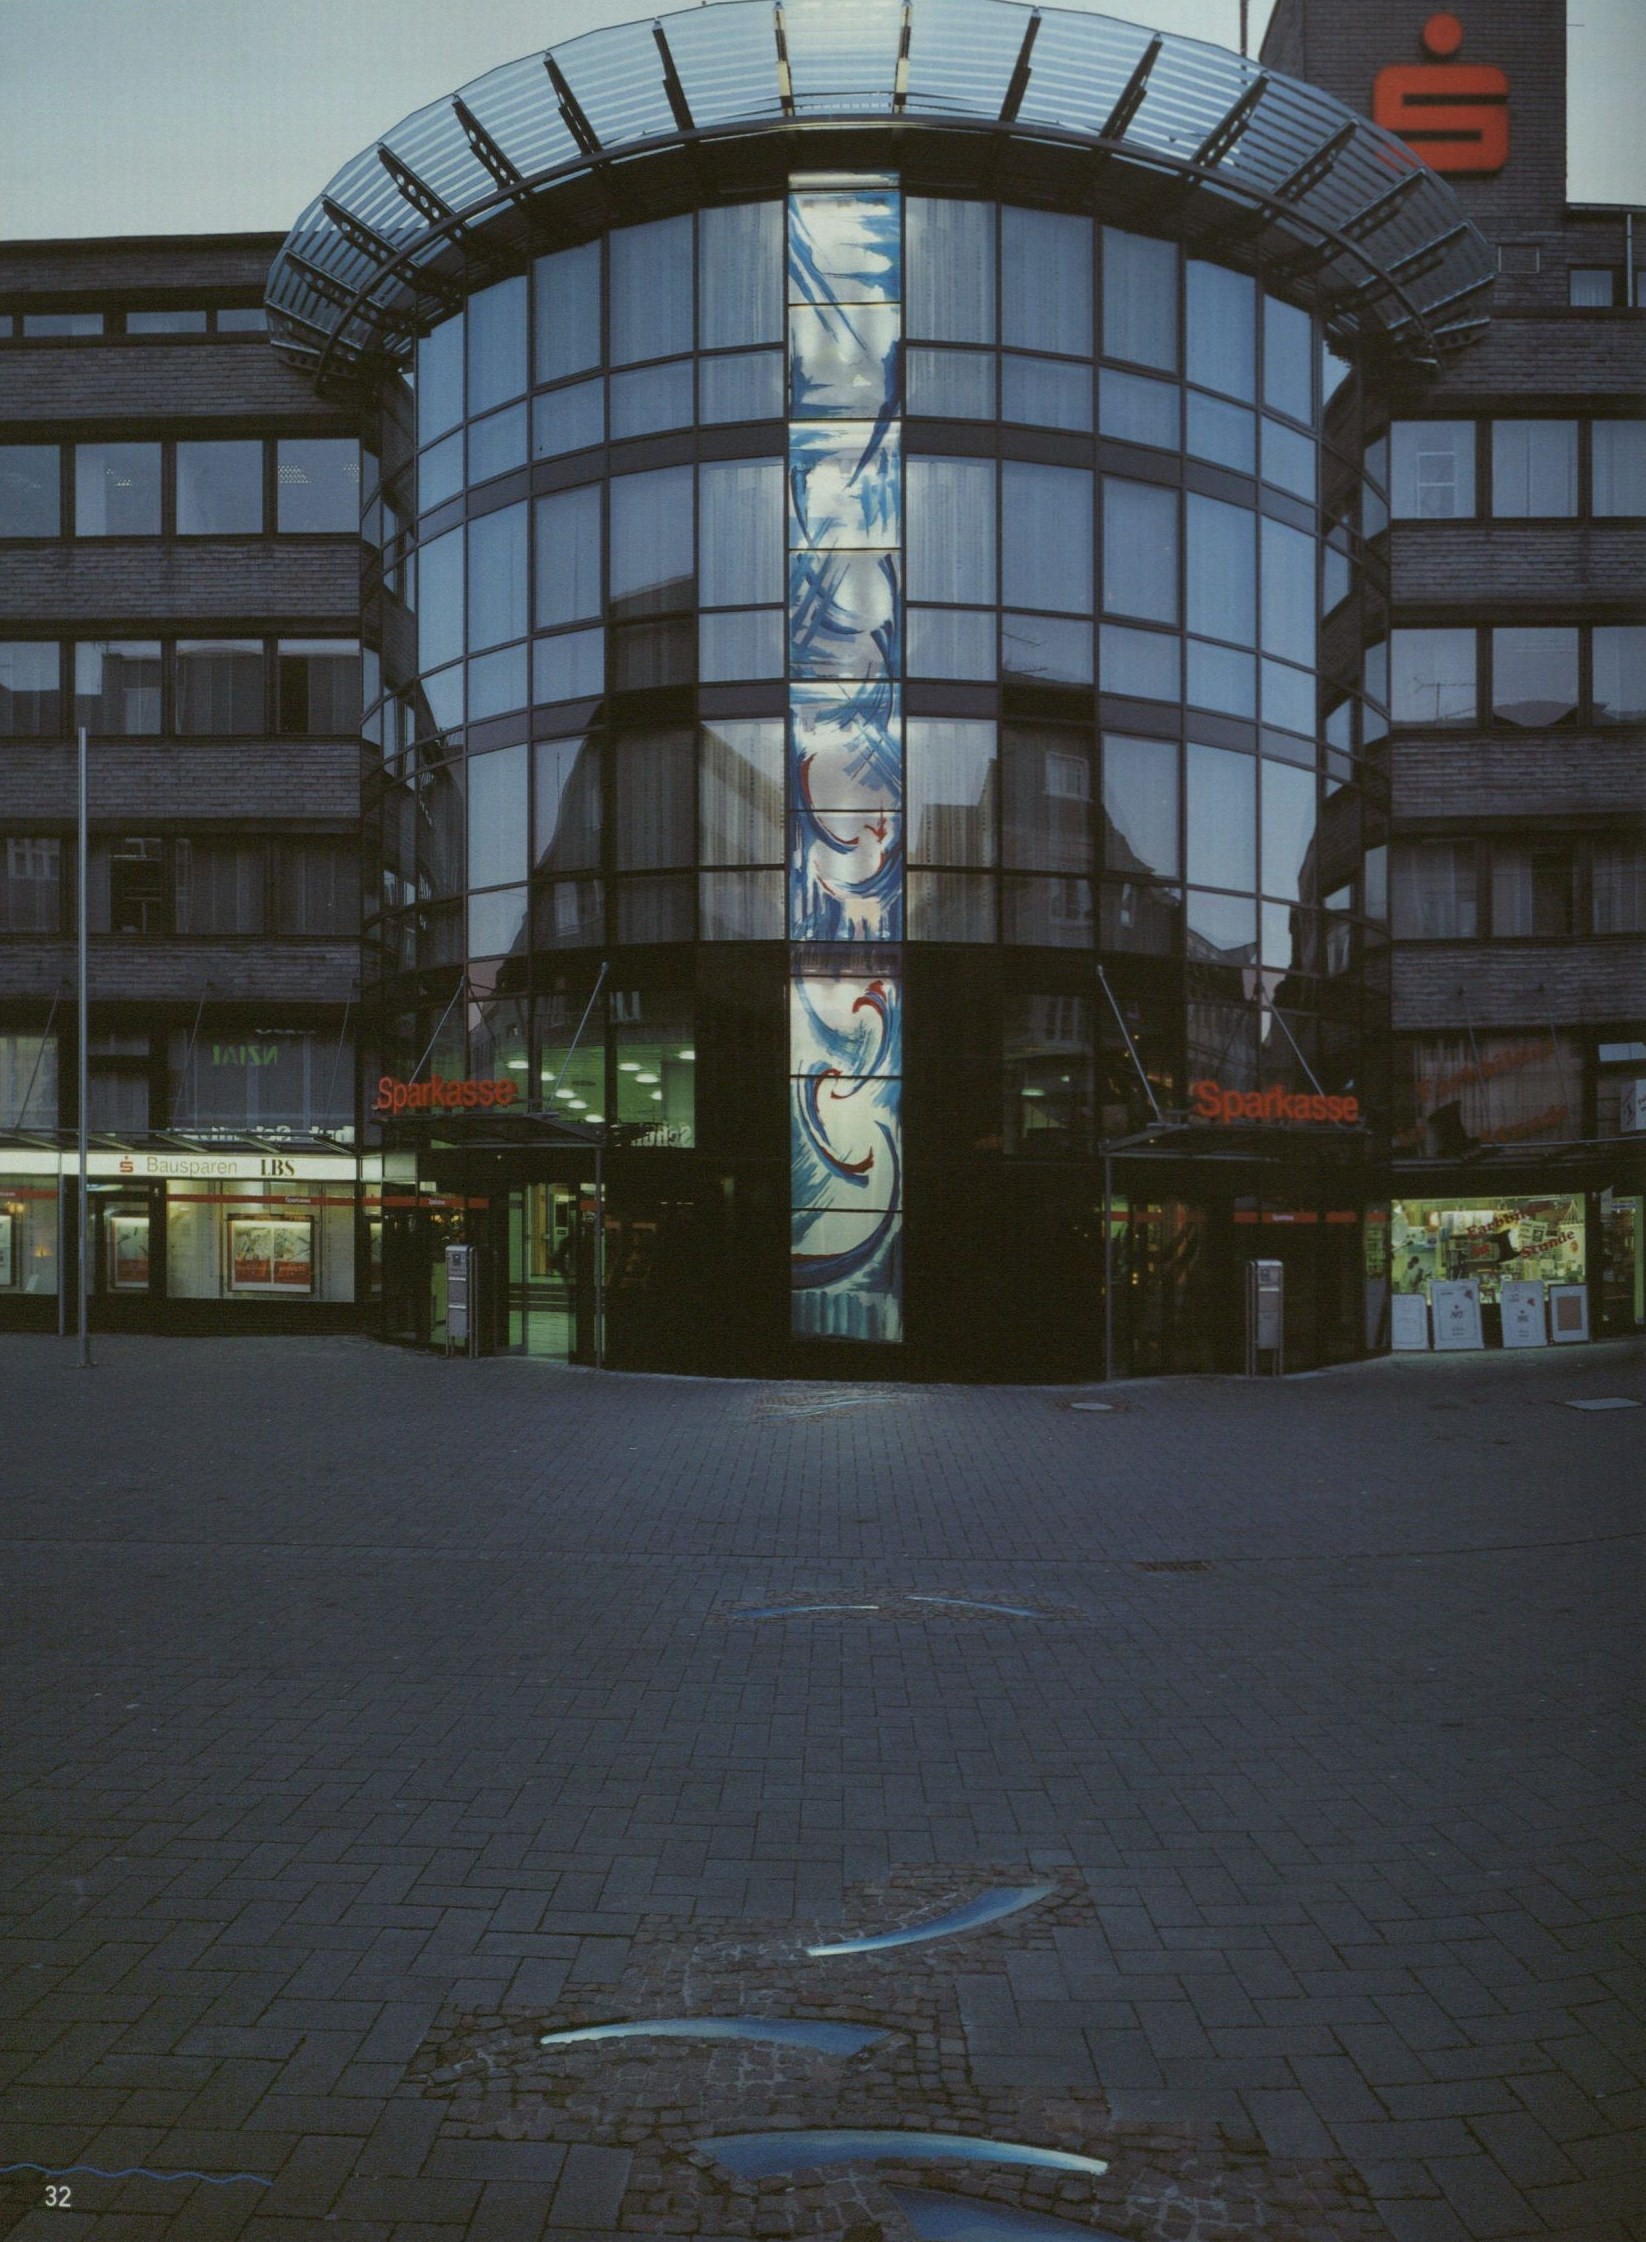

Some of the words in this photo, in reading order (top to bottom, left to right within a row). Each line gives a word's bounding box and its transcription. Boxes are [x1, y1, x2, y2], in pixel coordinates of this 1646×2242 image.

[377, 1074, 517, 1114] Sparkasse
[1193, 1079, 1359, 1124] Sparkasse
[146, 1156, 237, 1178] Bausparen
[261, 1159, 295, 1177] LBS
[1520, 1230, 1575, 1259] Stunde
